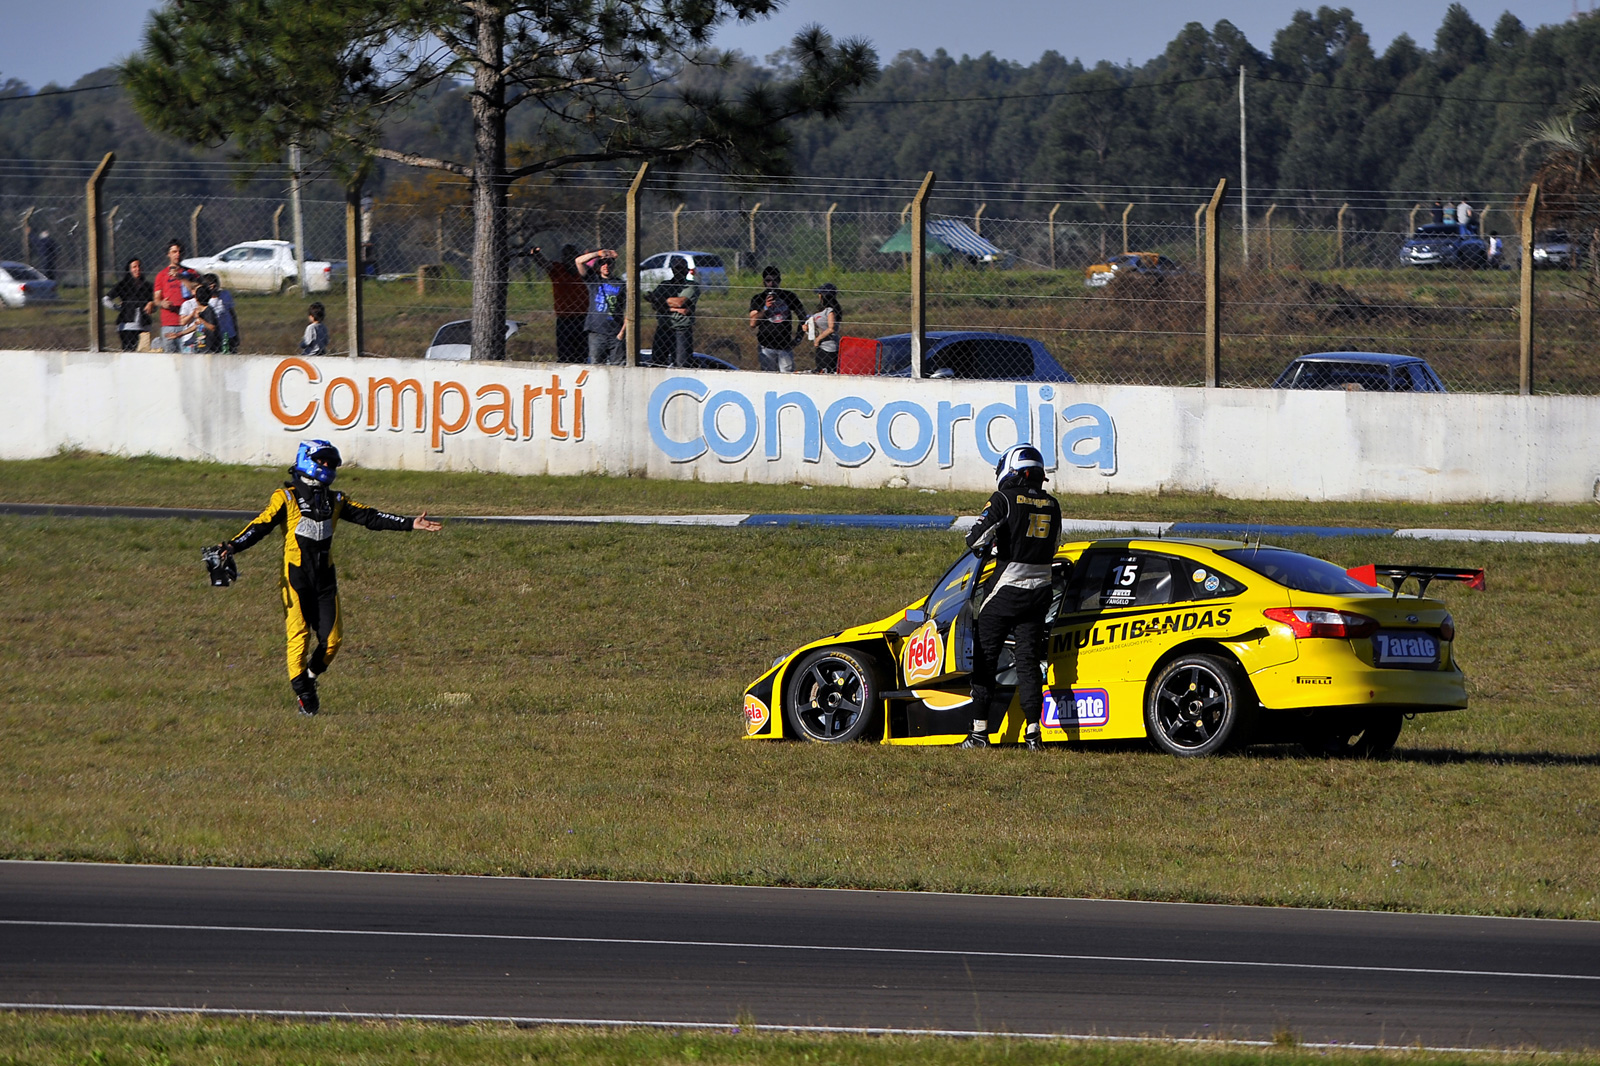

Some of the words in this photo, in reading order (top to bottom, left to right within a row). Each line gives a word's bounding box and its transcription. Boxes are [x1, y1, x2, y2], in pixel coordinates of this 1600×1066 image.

[270, 357, 590, 452] Compartí
[647, 376, 1119, 476] Concordia
[1026, 513, 1052, 538] 15
[1112, 565, 1139, 586] 15
[1053, 608, 1233, 654] MULTIBANDAS
[908, 628, 937, 670] Fela
[1296, 676, 1332, 684] PIRELLI
